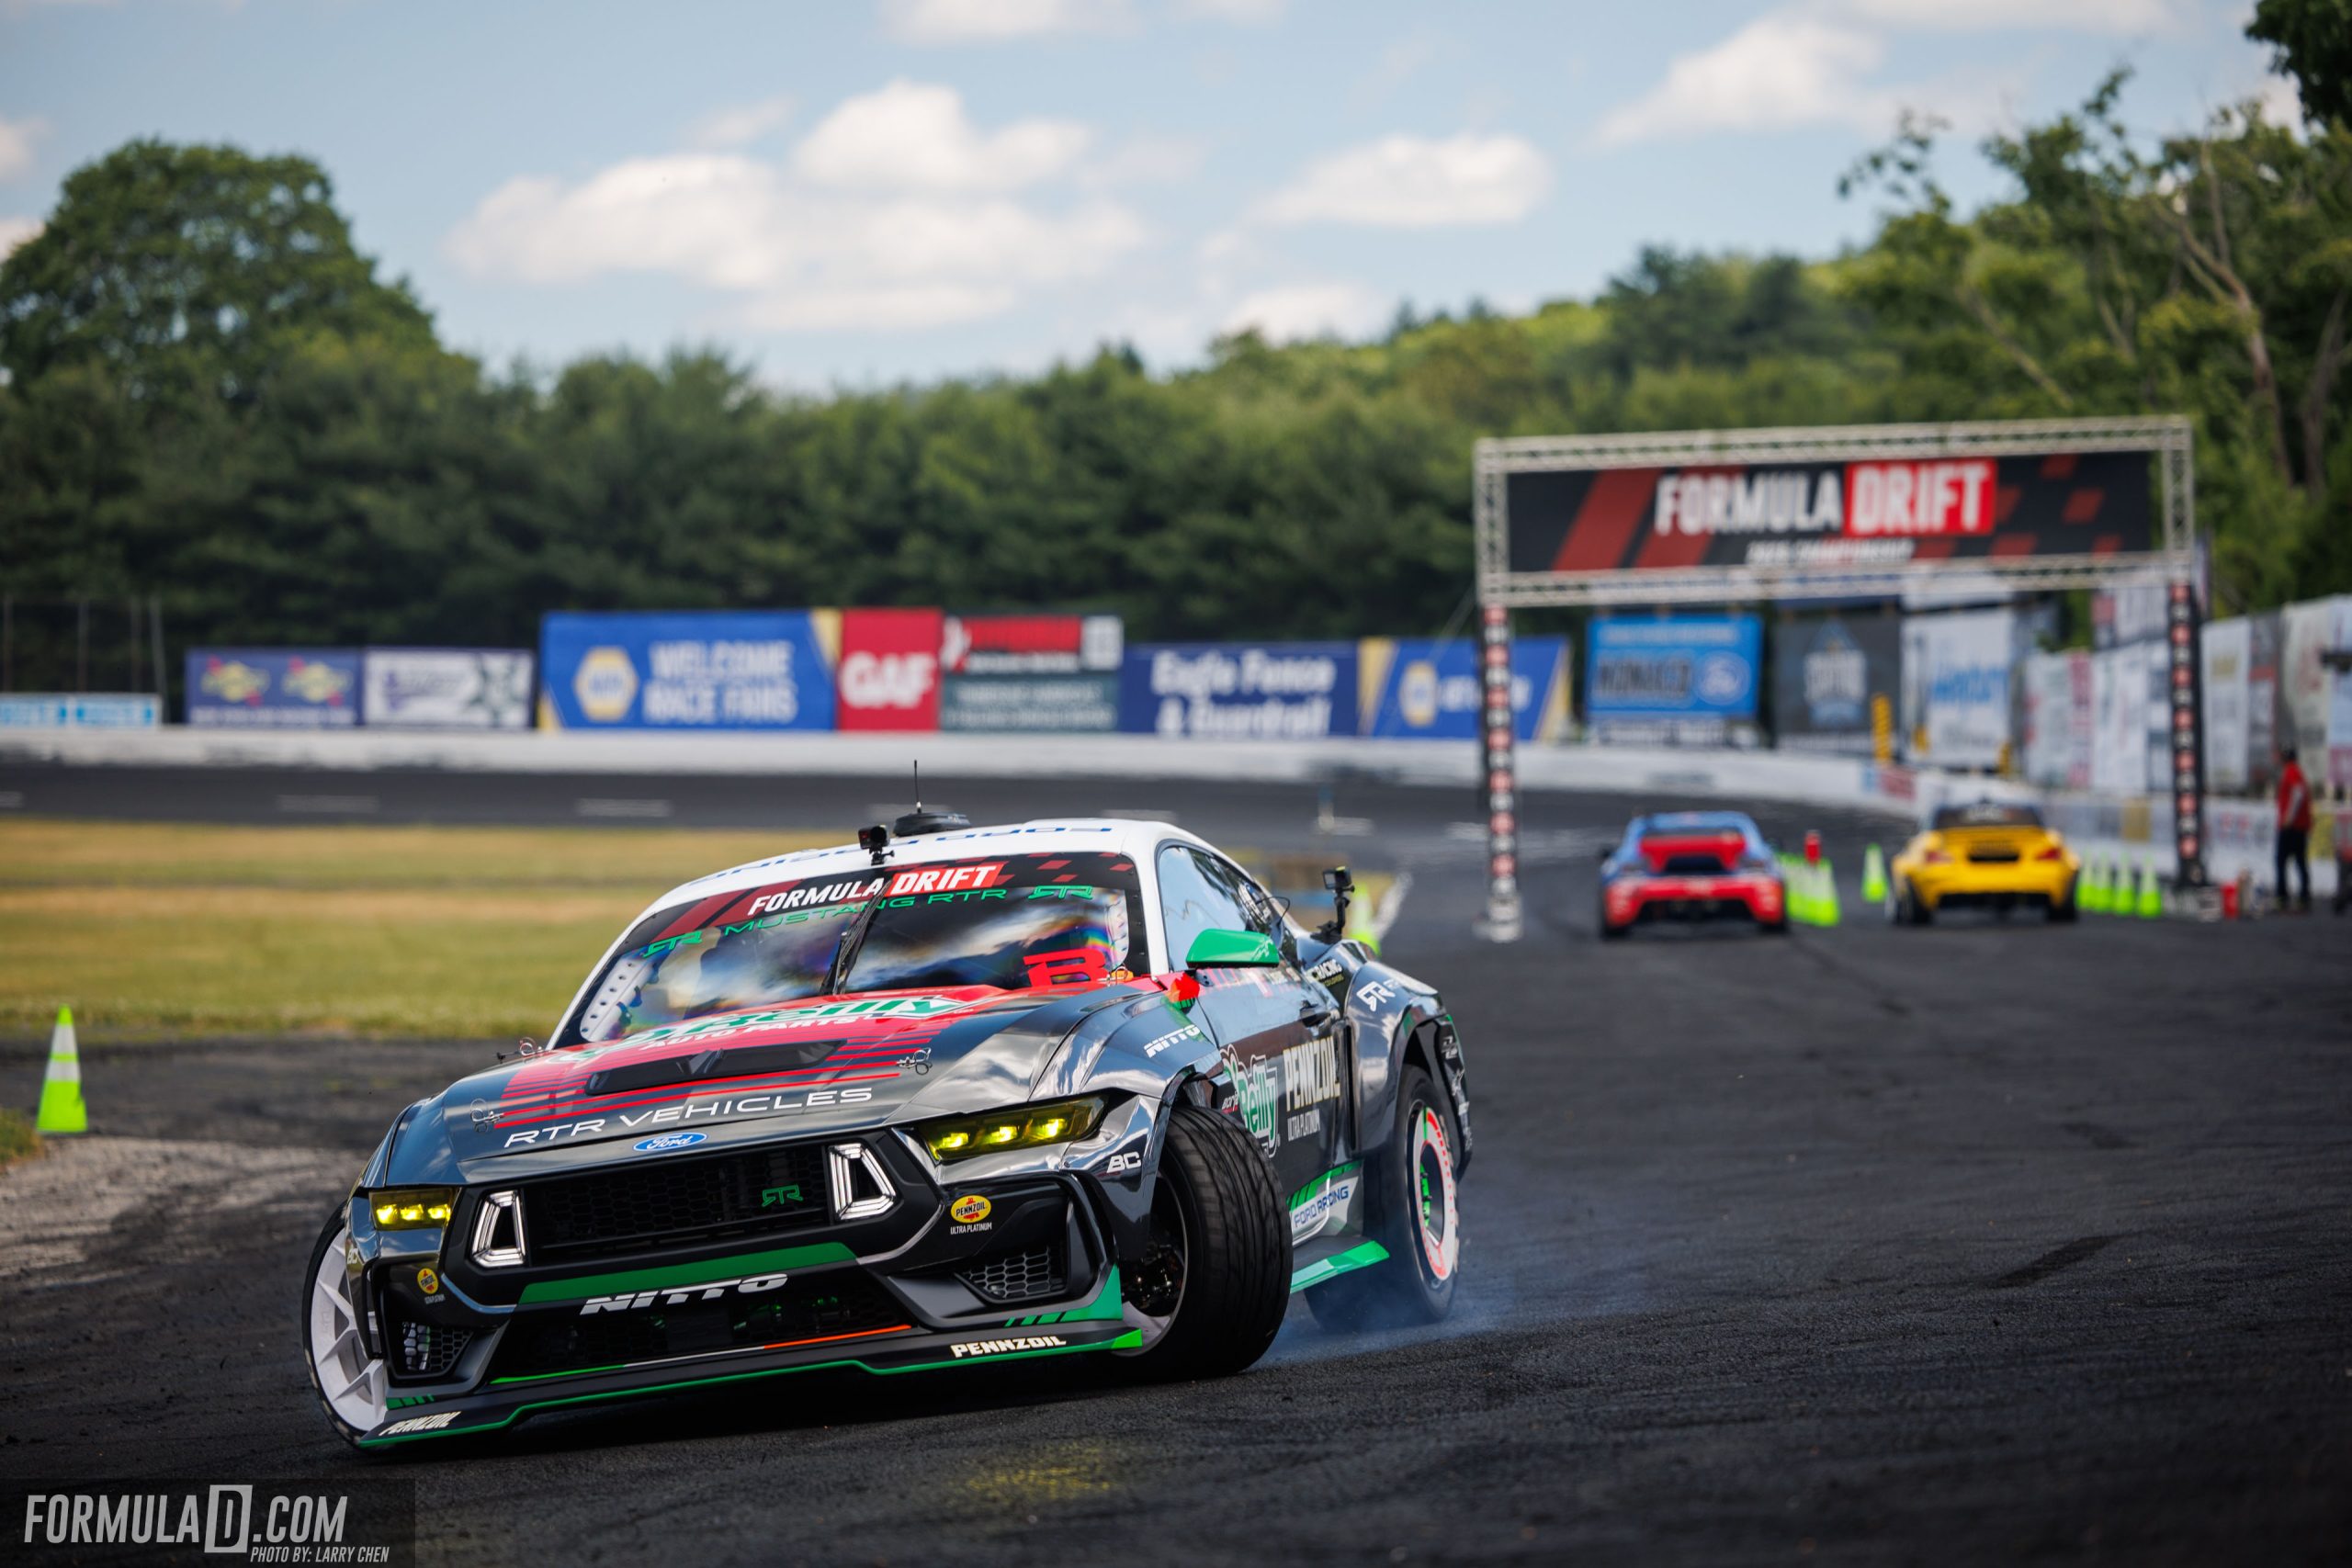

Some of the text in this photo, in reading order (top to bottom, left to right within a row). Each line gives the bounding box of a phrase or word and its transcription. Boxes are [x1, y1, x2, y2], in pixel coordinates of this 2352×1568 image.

[1655, 462, 1990, 535] FORMULA DRIFT
[650, 640, 794, 679] WELCOME
[840, 651, 935, 710] GAF
[643, 682, 797, 724] RACE FANS
[747, 865, 997, 918] FORMULA DRIFT
[724, 887, 1008, 937] MUSTANG RTR
[639, 1016, 862, 1051] AUTO PARTS
[1143, 1023, 1201, 1058] NITTO
[1283, 1037, 1340, 1112] PENNZOIL
[503, 1087, 873, 1148] RTR VEHICLES
[646, 1134, 695, 1150] Ford
[1106, 1151, 1142, 1174] BC
[956, 1201, 986, 1218] PENNZOIL
[1294, 1204, 1317, 1227] FORD
[950, 1222, 992, 1235] ULTRA PLATINUM
[580, 1273, 788, 1315] NITTO
[950, 1336, 1067, 1358] PENNZOIL
[379, 1410, 462, 1437] PENNZOIL
